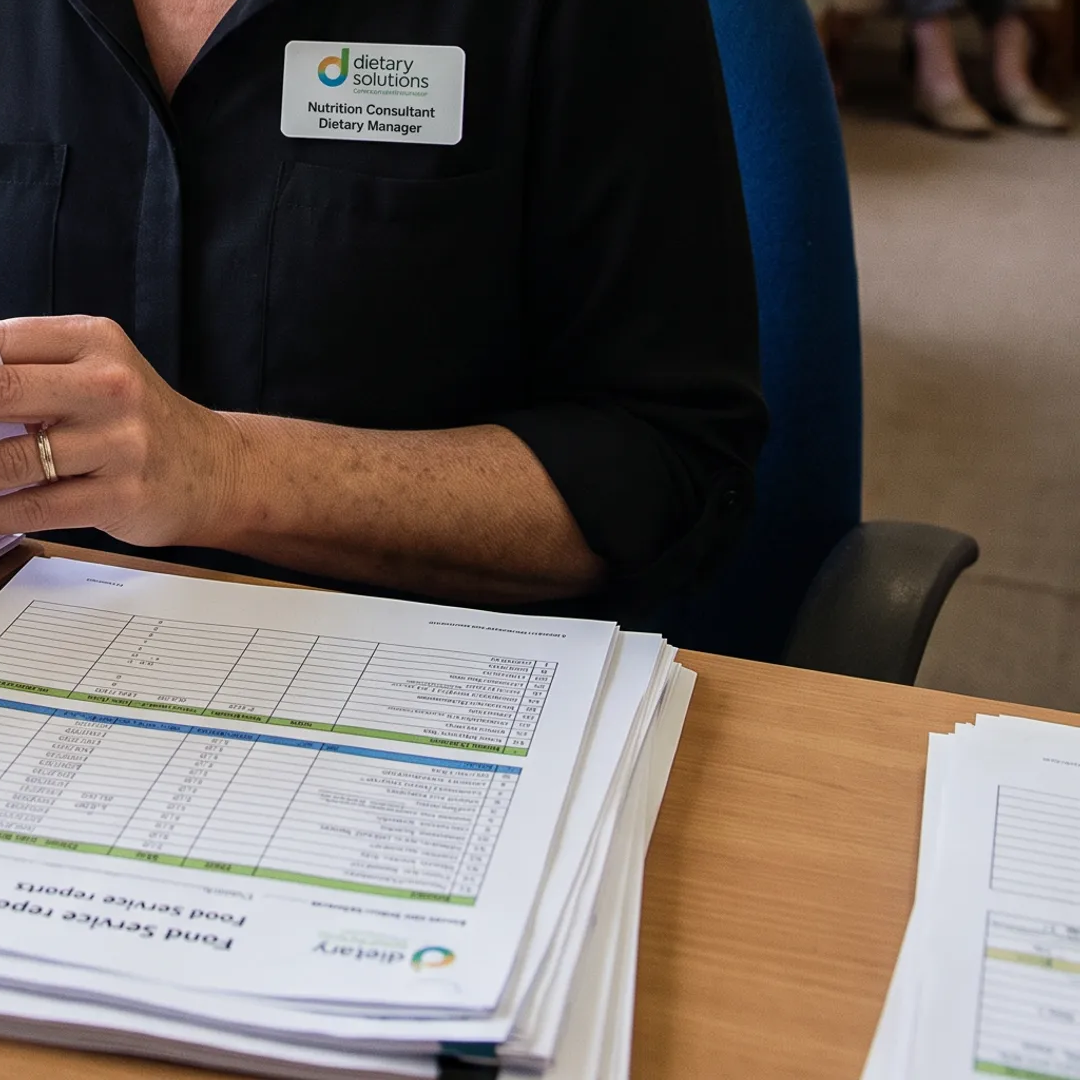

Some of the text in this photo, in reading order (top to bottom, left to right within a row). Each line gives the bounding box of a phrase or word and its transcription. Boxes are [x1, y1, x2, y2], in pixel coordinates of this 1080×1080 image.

[353, 55, 414, 74] dietary
[353, 73, 429, 89] solutions
[307, 101, 436, 119] Nutrition Consultant
[318, 118, 422, 136] Dietary Manager
[14, 882, 247, 928] Food Service reports
[62, 911, 159, 938] Service
